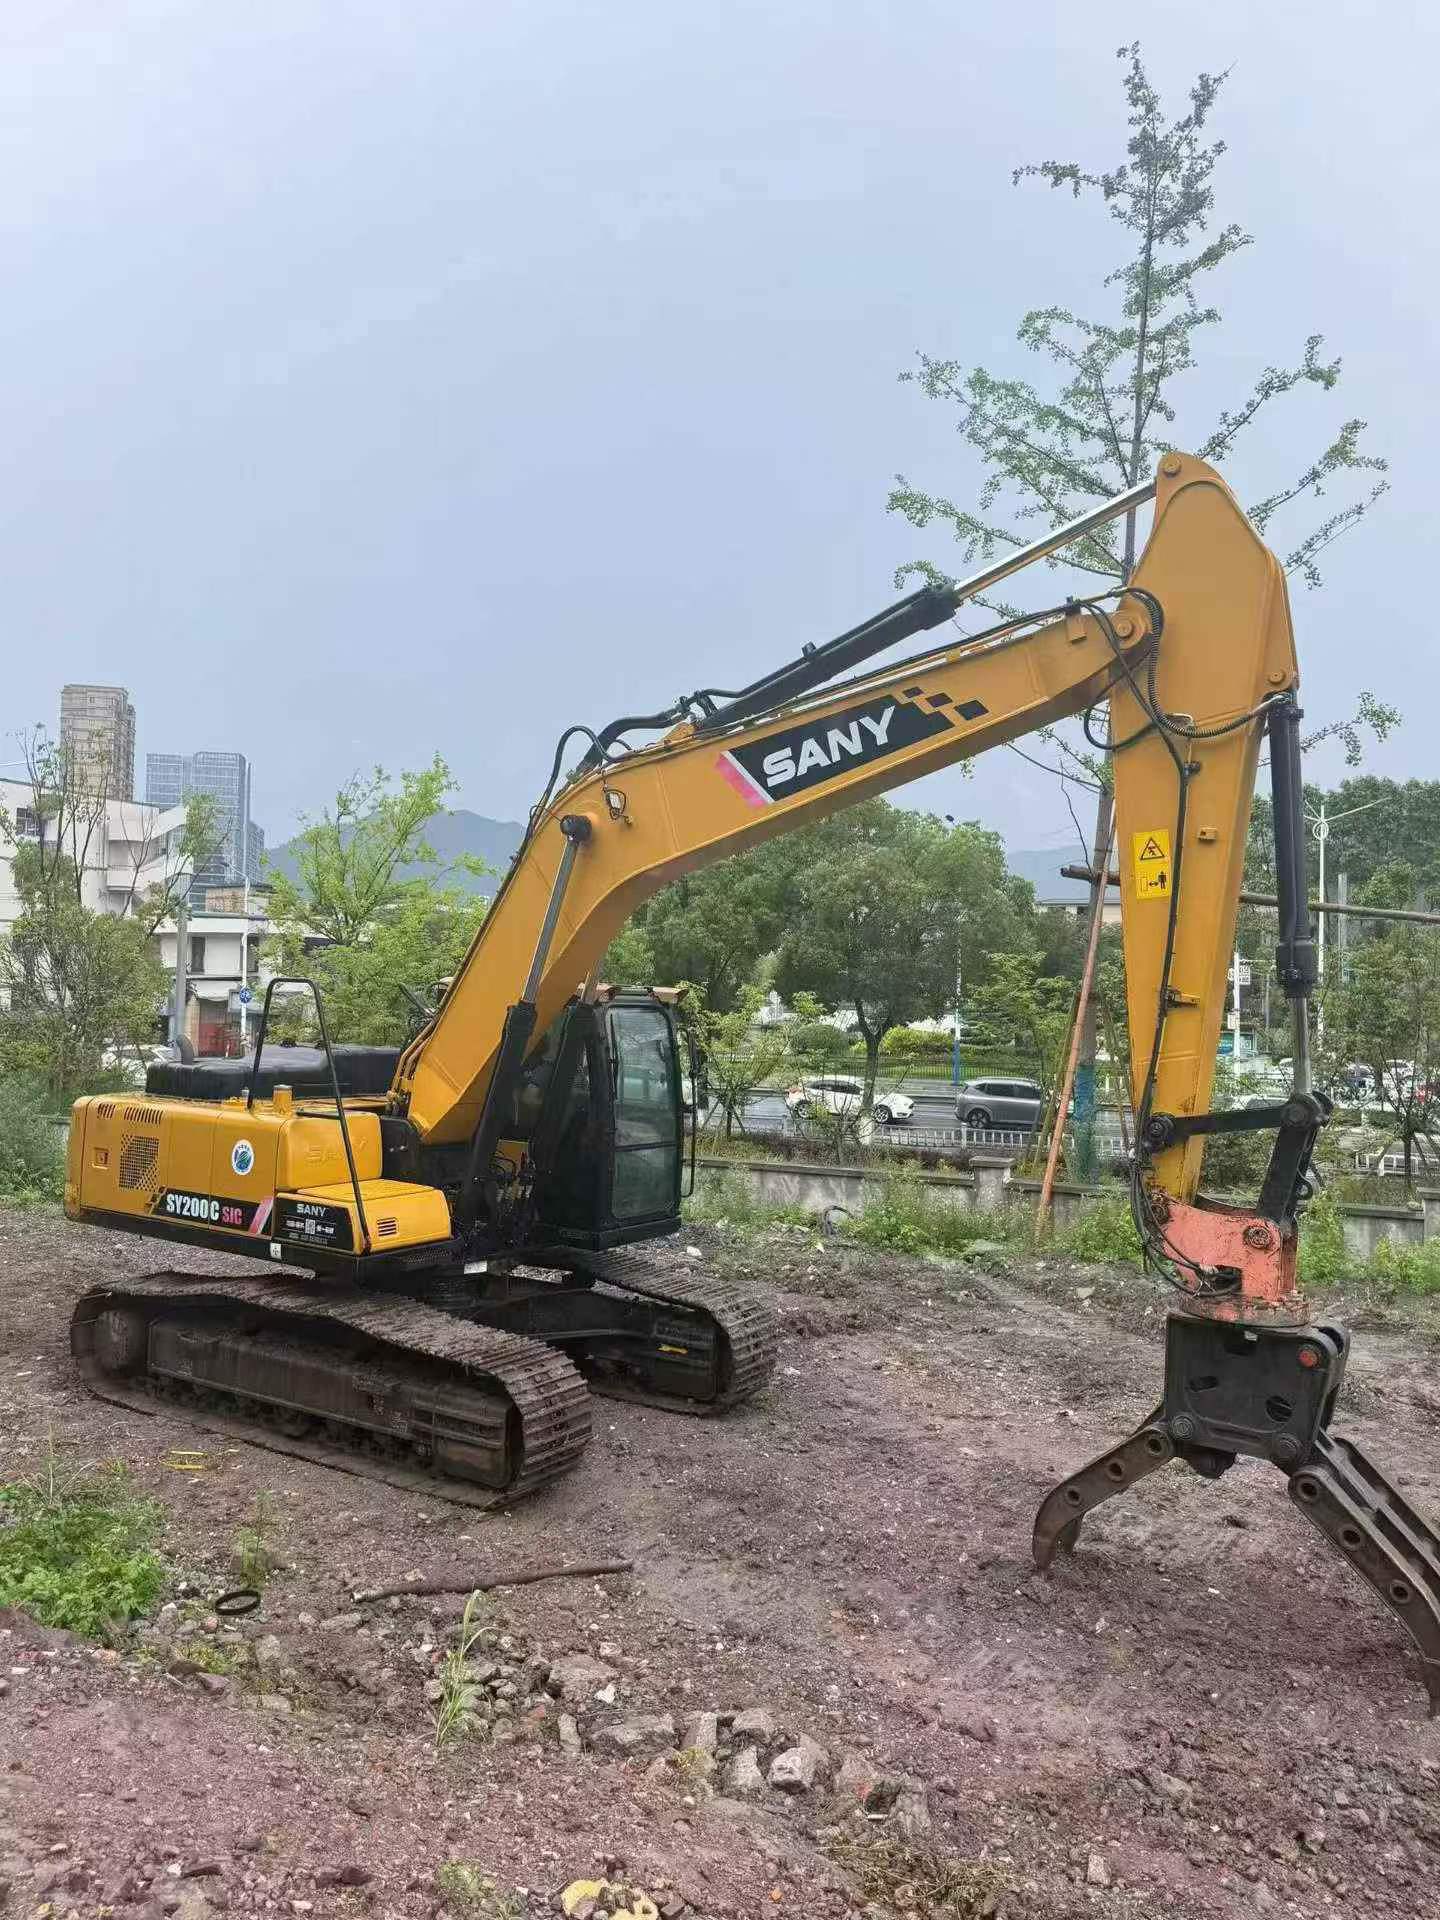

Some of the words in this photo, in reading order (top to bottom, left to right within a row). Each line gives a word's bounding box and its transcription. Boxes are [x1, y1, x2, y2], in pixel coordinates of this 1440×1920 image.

[763, 706, 896, 787] SANY
[166, 1194, 220, 1221] SY200C
[296, 1203, 328, 1217] SANY
